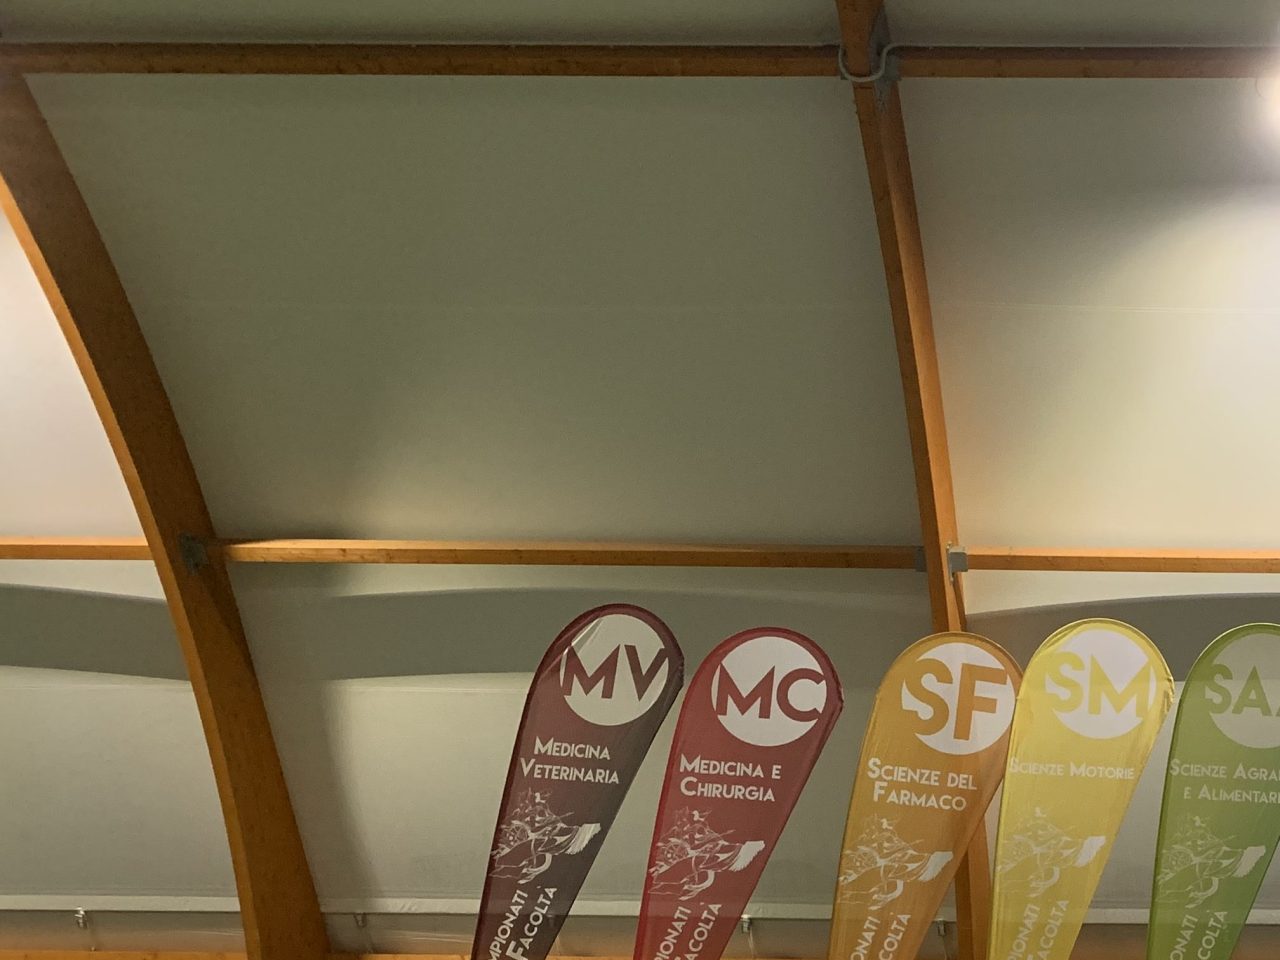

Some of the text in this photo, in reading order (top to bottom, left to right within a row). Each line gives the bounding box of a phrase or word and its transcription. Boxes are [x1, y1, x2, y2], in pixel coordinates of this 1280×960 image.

[563, 643, 668, 702] MV
[1046, 651, 1150, 718] SM
[715, 663, 826, 723] MC
[902, 657, 1008, 742] SF
[533, 736, 611, 761] MEDICINA
[520, 757, 619, 785] VETERINARIA
[679, 753, 782, 780] MEDICINA E
[867, 757, 978, 791] SCIENZE DEL
[1009, 758, 1135, 780] SCIENZE MOTORIE
[1169, 758, 1227, 778] SCIENZE
[680, 776, 776, 802] CHIRURGIA
[872, 781, 967, 811] FARMACO
[1183, 783, 1280, 804] E ALIMENTARI
